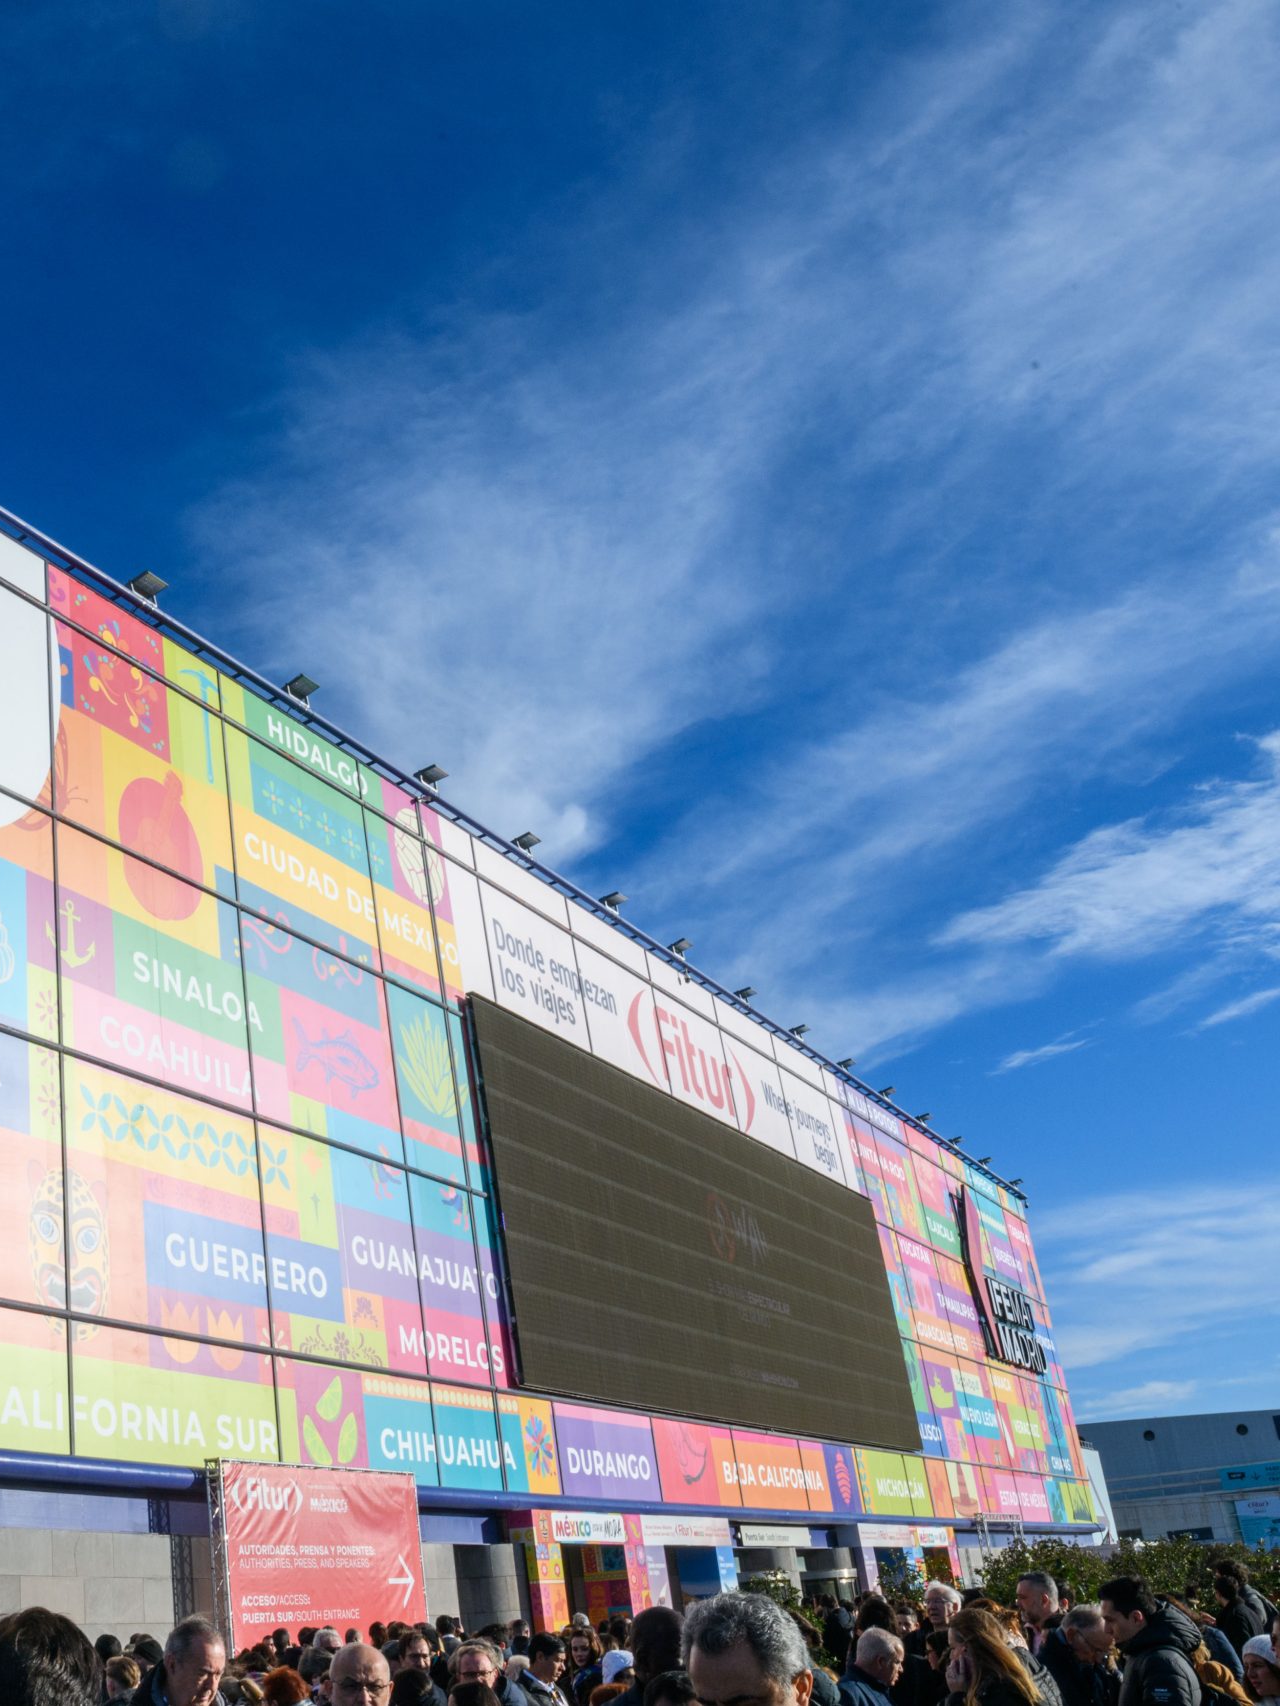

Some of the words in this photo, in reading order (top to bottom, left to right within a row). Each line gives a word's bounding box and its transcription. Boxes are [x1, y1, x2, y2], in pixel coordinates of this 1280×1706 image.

[267, 714, 368, 795] HIDALGO
[244, 832, 339, 900] CIUDAD
[346, 887, 376, 924] DE
[383, 907, 459, 966] MÉXIO
[492, 918, 546, 974] Donde
[550, 958, 618, 1016] empiezan
[498, 954, 526, 998] los
[530, 977, 577, 1025] viajes
[133, 951, 263, 1032] SINALOA
[100, 1015, 260, 1103] COAHUILA
[793, 1100, 831, 1147] journeys
[812, 1135, 839, 1171] begin
[165, 1232, 328, 1298] GUERRERO
[987, 1278, 1034, 1331] IFEMA
[399, 1325, 504, 1373] MORELOS
[997, 1322, 1048, 1374] MADRID
[217, 1414, 277, 1455] SUR
[380, 1428, 517, 1470] CHIHUAHUA
[919, 1423, 942, 1442] LISCO
[567, 1447, 651, 1480] DURANGO
[722, 1461, 757, 1486] BAJA
[758, 1465, 824, 1491] CALIFORNIA
[876, 1478, 926, 1498] MICHOACÁN
[238, 1544, 298, 1556] AUTORIDADES,
[300, 1545, 329, 1555] PRENSA
[331, 1546, 335, 1555] Y
[294, 1558, 318, 1569] PRESS,
[320, 1559, 335, 1569] AND
[336, 1559, 370, 1568] SPEAKERS
[242, 1612, 276, 1624] PUERTA
[324, 1608, 360, 1619] ENTRANCE
